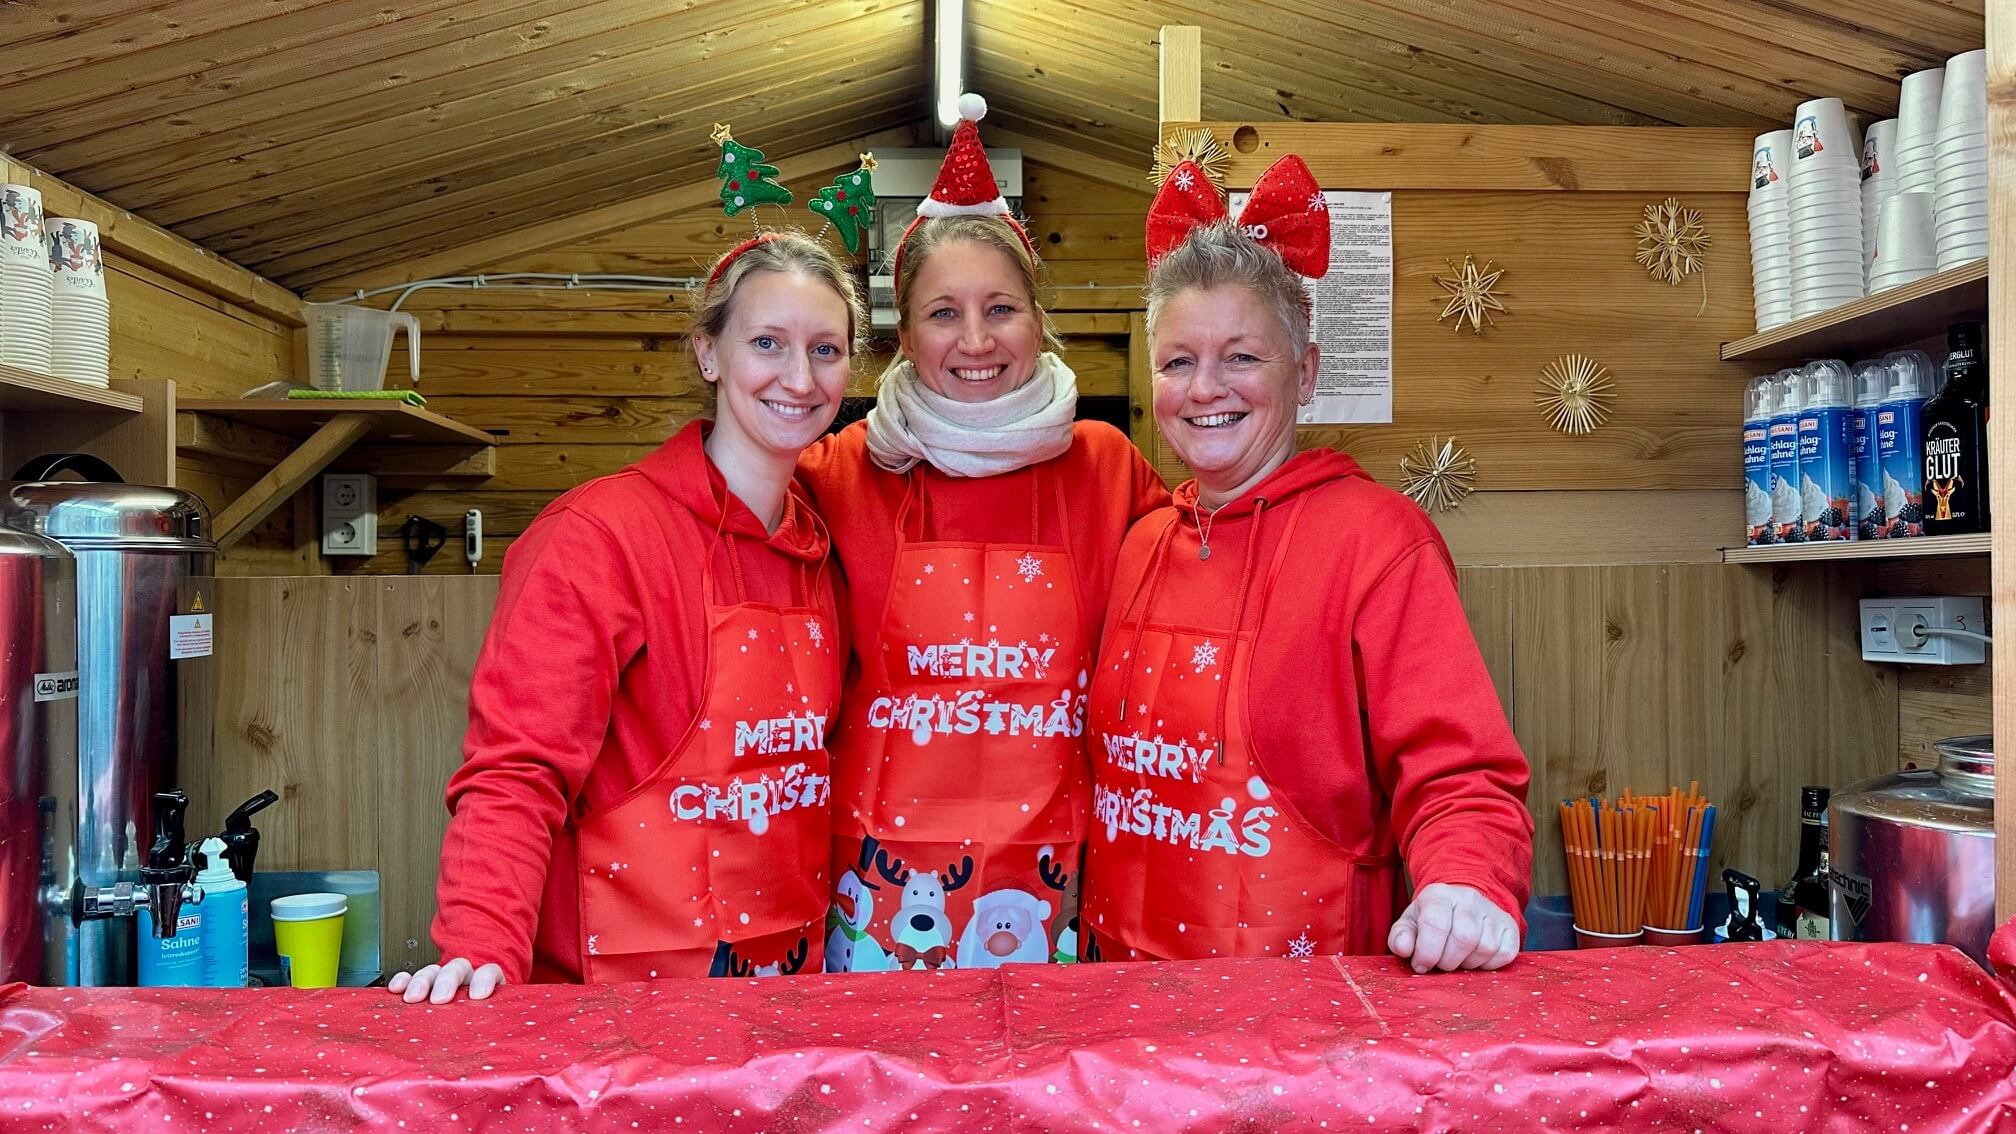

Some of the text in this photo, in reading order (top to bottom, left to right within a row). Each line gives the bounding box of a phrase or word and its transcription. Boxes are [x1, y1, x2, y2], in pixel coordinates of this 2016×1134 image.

[1950, 349, 1973, 360] ERGLUT
[1926, 437, 1960, 456] KRÄUTER
[1926, 453, 1961, 480] GLUT
[1956, 615, 1967, 631] 3
[907, 640, 1056, 679] MERRY
[868, 691, 1088, 738] CHRISTMAS
[1103, 733, 1214, 783] MERRY
[180, 916, 199, 927] SANI
[161, 936, 200, 951] Sahne
